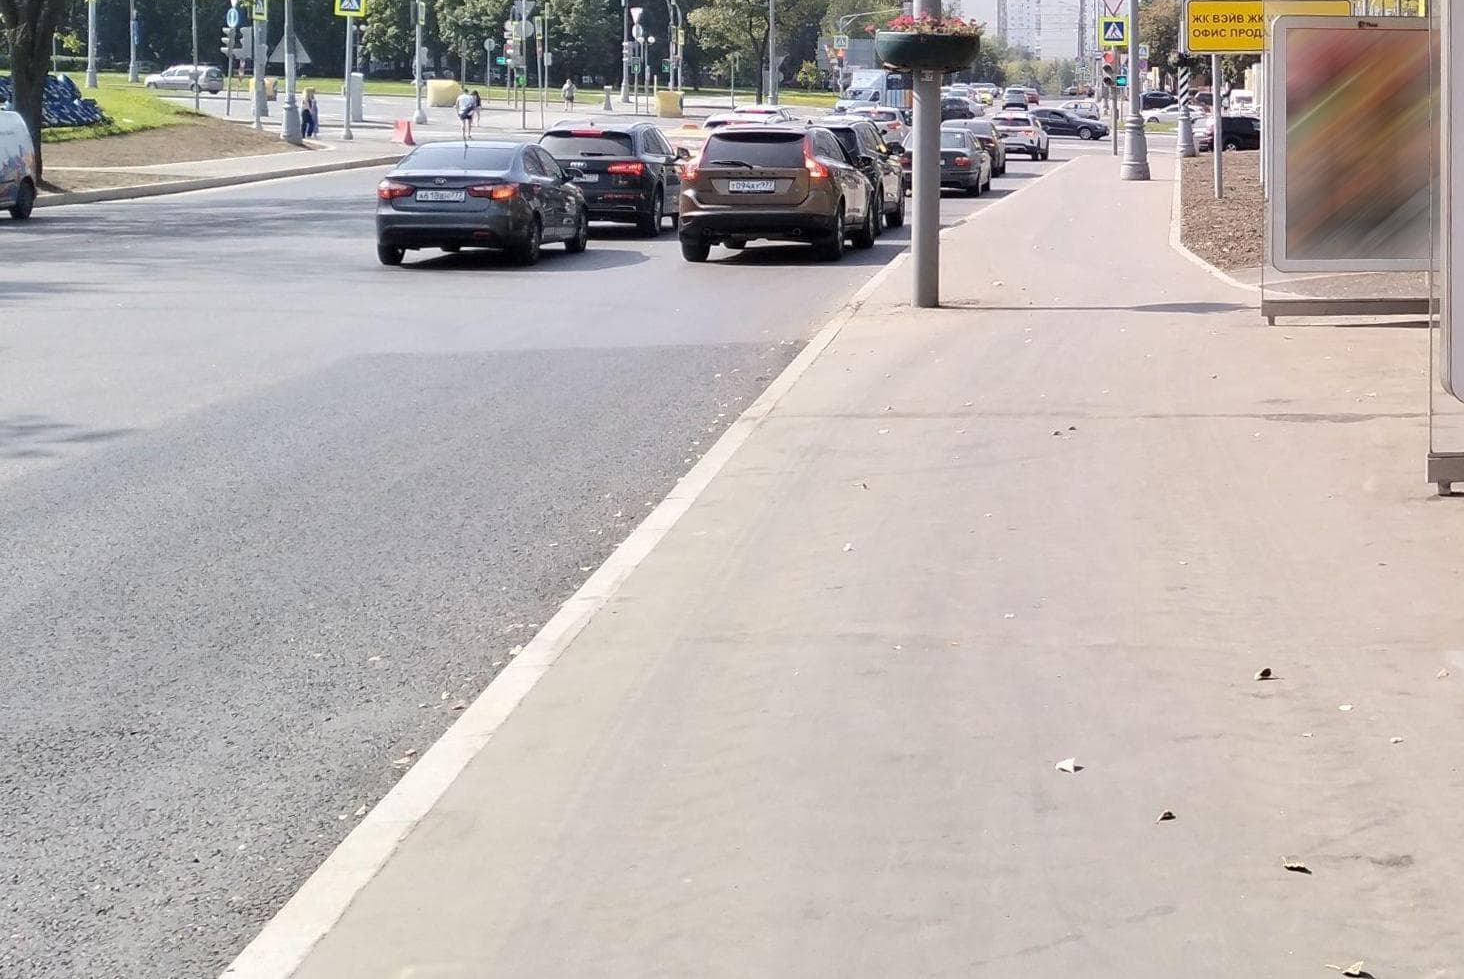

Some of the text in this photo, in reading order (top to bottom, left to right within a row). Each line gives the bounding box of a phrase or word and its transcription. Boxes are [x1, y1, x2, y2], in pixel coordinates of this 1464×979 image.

[1192, 14, 1209, 23] ЖК
[1212, 13, 1245, 24] ВЭЙВ
[1248, 13, 1264, 24] ЖК
[1192, 28, 1227, 38] ОФИС
